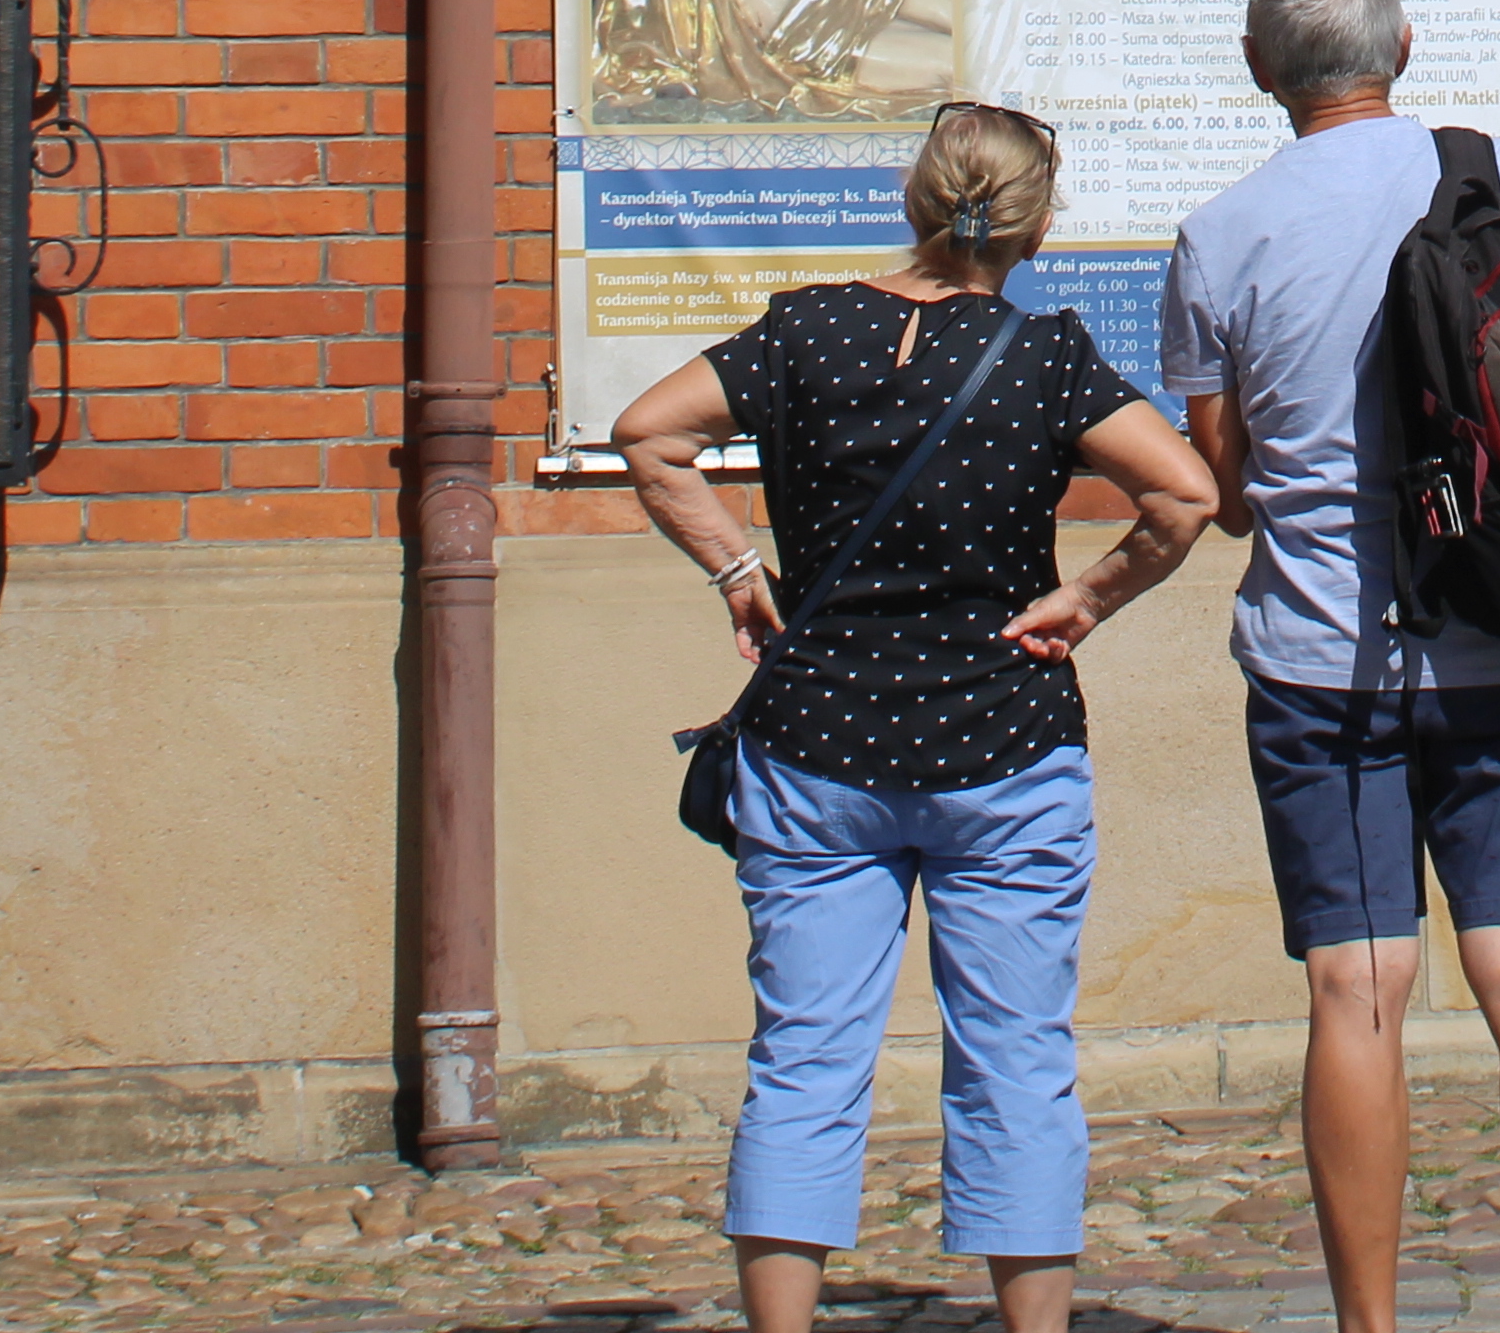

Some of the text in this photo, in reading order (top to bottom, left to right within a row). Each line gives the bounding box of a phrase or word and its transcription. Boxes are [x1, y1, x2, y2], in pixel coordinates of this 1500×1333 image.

[600, 188, 905, 207] Kaznodzieja Tygodnia Maryjnego: ks. Barto
[612, 211, 676, 229] dyrektor
[677, 210, 778, 228] Wydawnictwa
[781, 209, 836, 226] Diecezji
[839, 208, 907, 223] Tarnowsk
[1032, 257, 1163, 276] W dni powszednie
[595, 268, 871, 287] Transmisja Mszy św. w RDN Małopolska
[595, 292, 670, 306] codziennie
[673, 294, 684, 305] o
[687, 290, 725, 308] godz.
[596, 313, 668, 328] Transmisja
